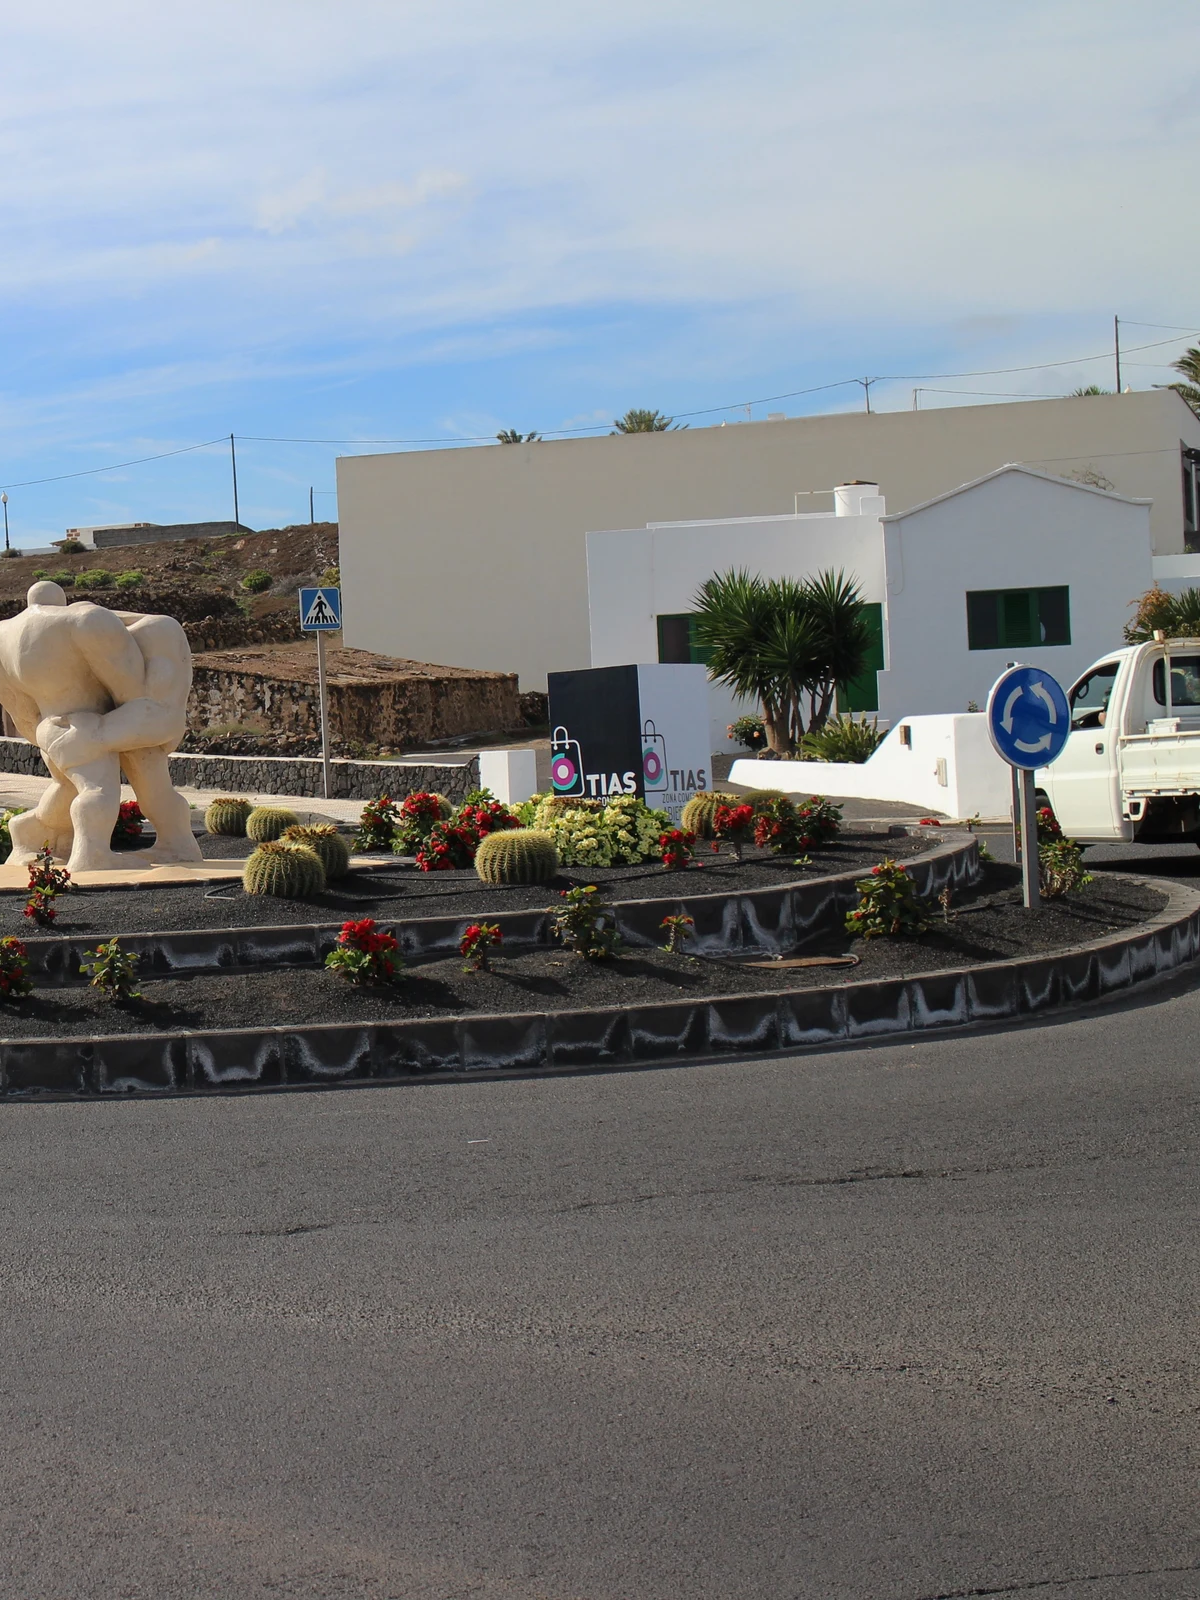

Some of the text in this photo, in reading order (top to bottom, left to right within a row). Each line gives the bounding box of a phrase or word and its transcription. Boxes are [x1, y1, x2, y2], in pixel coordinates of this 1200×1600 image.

[586, 771, 637, 796] TIAS
[670, 769, 706, 791] TIAS
[662, 793, 677, 804] ZONA
